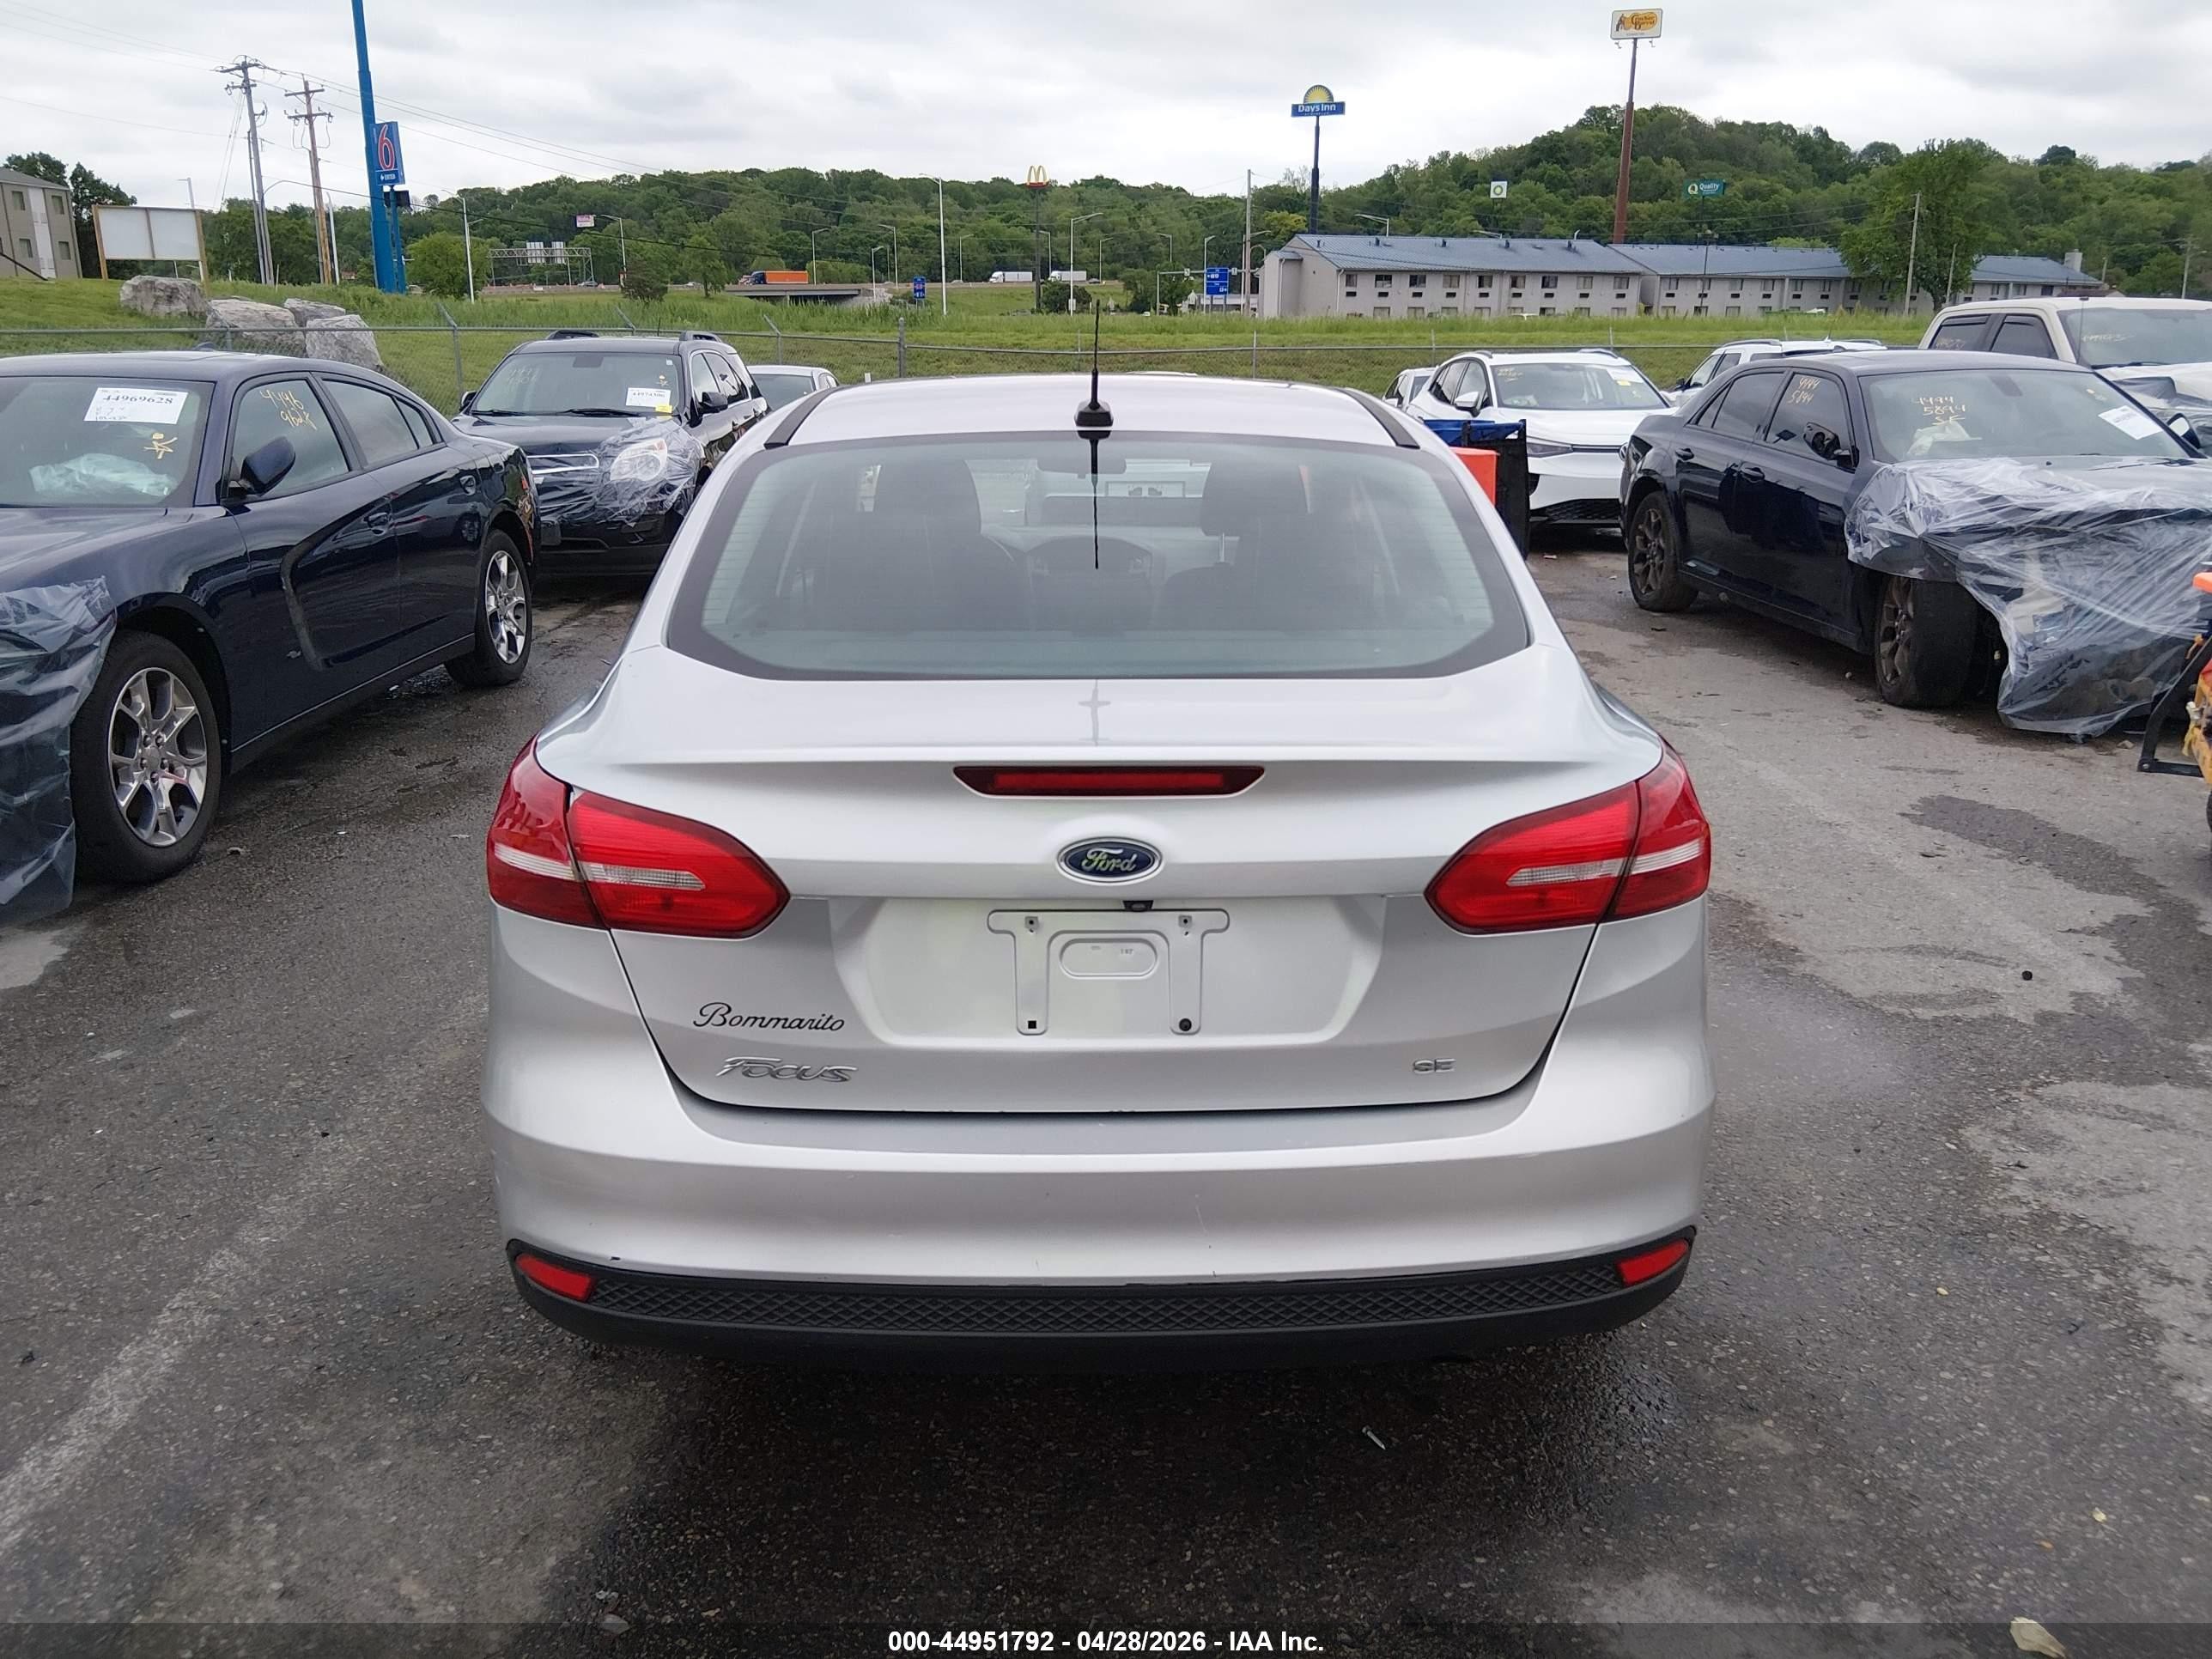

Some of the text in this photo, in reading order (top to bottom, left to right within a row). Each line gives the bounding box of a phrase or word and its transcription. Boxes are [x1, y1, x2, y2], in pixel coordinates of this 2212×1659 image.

[1298, 104, 1321, 114] Days
[1322, 103, 1336, 112] Inn
[378, 124, 395, 171] 6
[102, 394, 173, 404] 44969628
[1081, 847, 1138, 872] Ford
[692, 1001, 845, 1031] Bommarito
[1413, 1058, 1456, 1074] SE
